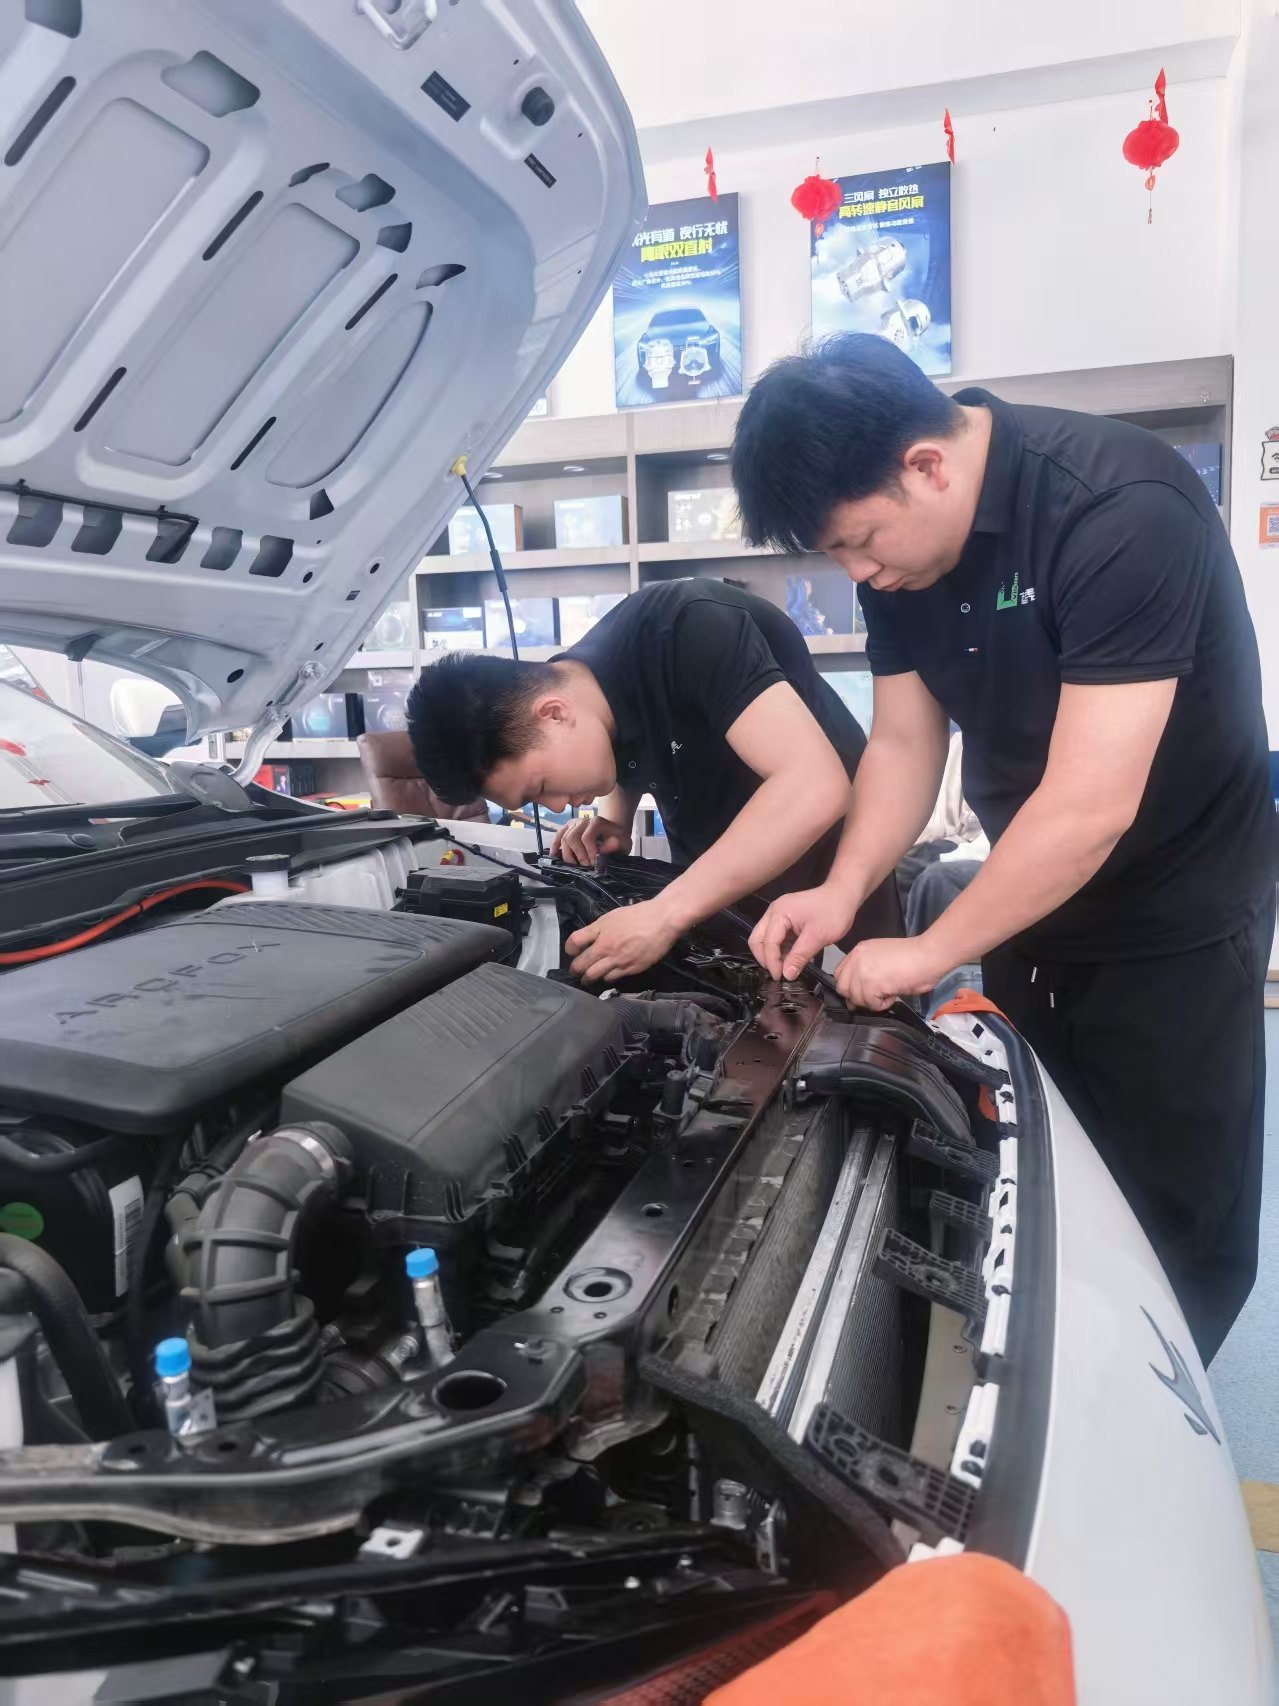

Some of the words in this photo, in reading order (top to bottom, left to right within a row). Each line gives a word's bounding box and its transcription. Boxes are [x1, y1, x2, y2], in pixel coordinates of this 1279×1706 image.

[843, 190, 875, 204] 三风扇
[878, 183, 919, 199] 独立散热
[838, 195, 925, 219] 高转速静音风扇
[679, 220, 728, 241] 夜行无忧
[53, 939, 281, 1025] ARCFOX
